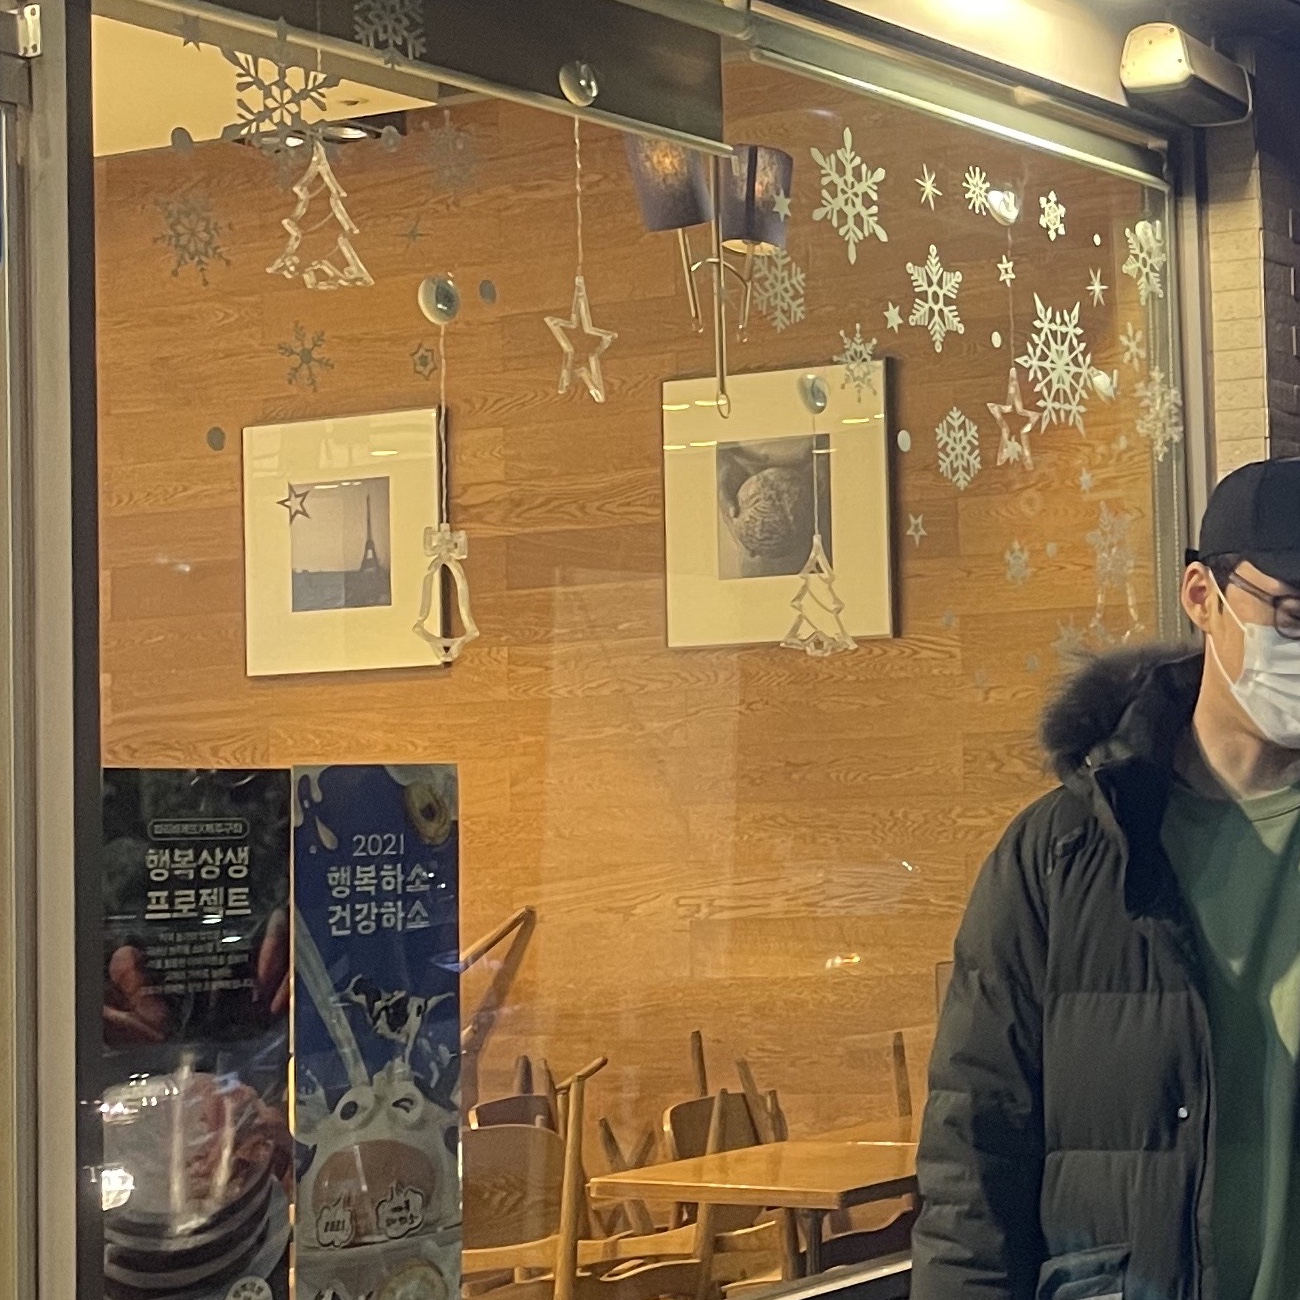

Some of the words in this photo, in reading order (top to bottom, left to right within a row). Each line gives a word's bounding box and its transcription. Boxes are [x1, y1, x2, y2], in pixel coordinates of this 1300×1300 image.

[352, 832, 404, 857] 2021
[145, 846, 249, 882] 행복상생
[326, 863, 431, 899] 행복하소
[144, 886, 251, 920] 프로젝트
[328, 900, 431, 937] 건강하소
